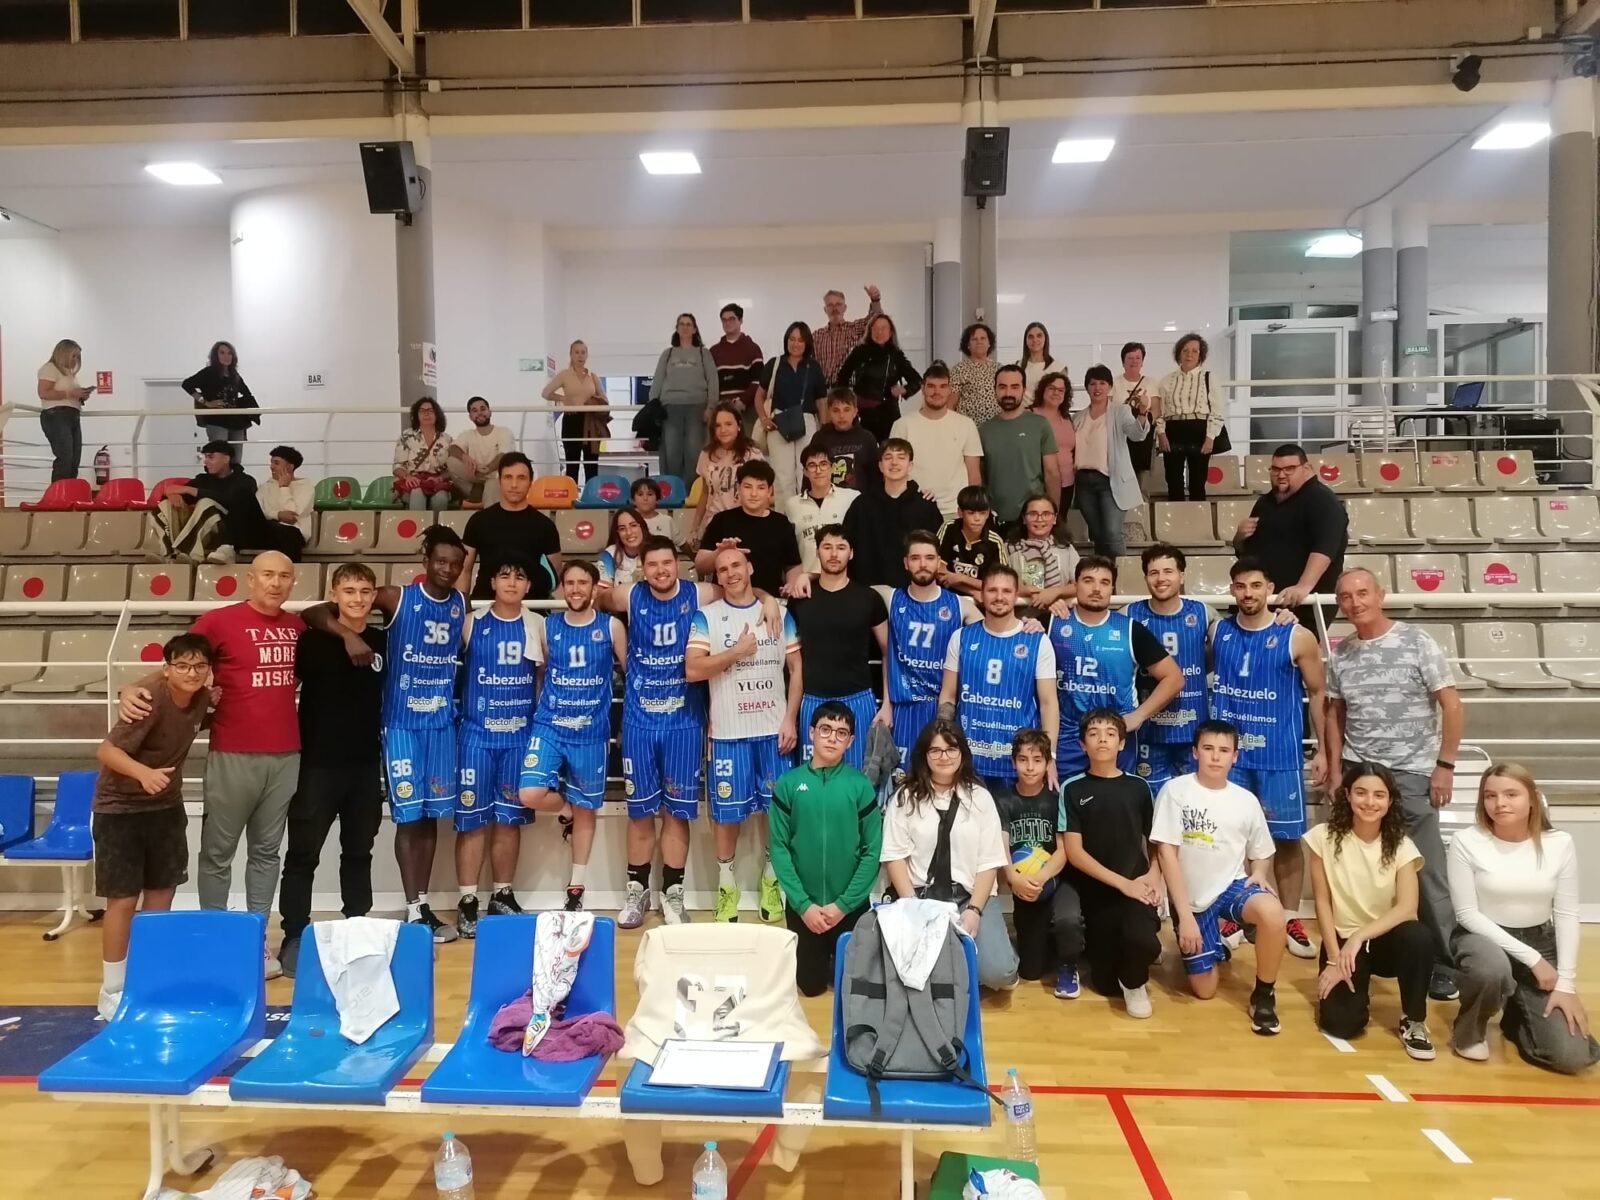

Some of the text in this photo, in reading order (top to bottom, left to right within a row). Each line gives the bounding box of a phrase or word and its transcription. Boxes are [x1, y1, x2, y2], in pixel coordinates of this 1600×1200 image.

[308, 374, 322, 384] BAR
[245, 627, 299, 641] TAKE
[423, 620, 450, 645] 36
[653, 621, 677, 646] 10
[908, 621, 936, 648] 77
[497, 641, 522, 665] 19
[1163, 632, 1179, 656] 9
[259, 646, 296, 664] MORE
[568, 644, 587, 668] 11
[1238, 651, 1250, 677] 1
[986, 658, 1003, 684] 8
[1075, 656, 1099, 677] 12
[738, 680, 773, 692] YUGO
[1057, 679, 1117, 695] Cabezuelo
[1212, 682, 1278, 700] Cabezuelo
[640, 698, 667, 706] Doctor
[961, 691, 1022, 709] Cabezuelo
[1222, 709, 1278, 723] Socuéllamos
[528, 736, 541, 750] 11
[803, 744, 814, 760] 13
[1140, 744, 1150, 759] 9
[391, 759, 412, 777] 36
[460, 768, 476, 785] 19
[716, 759, 733, 777] 23
